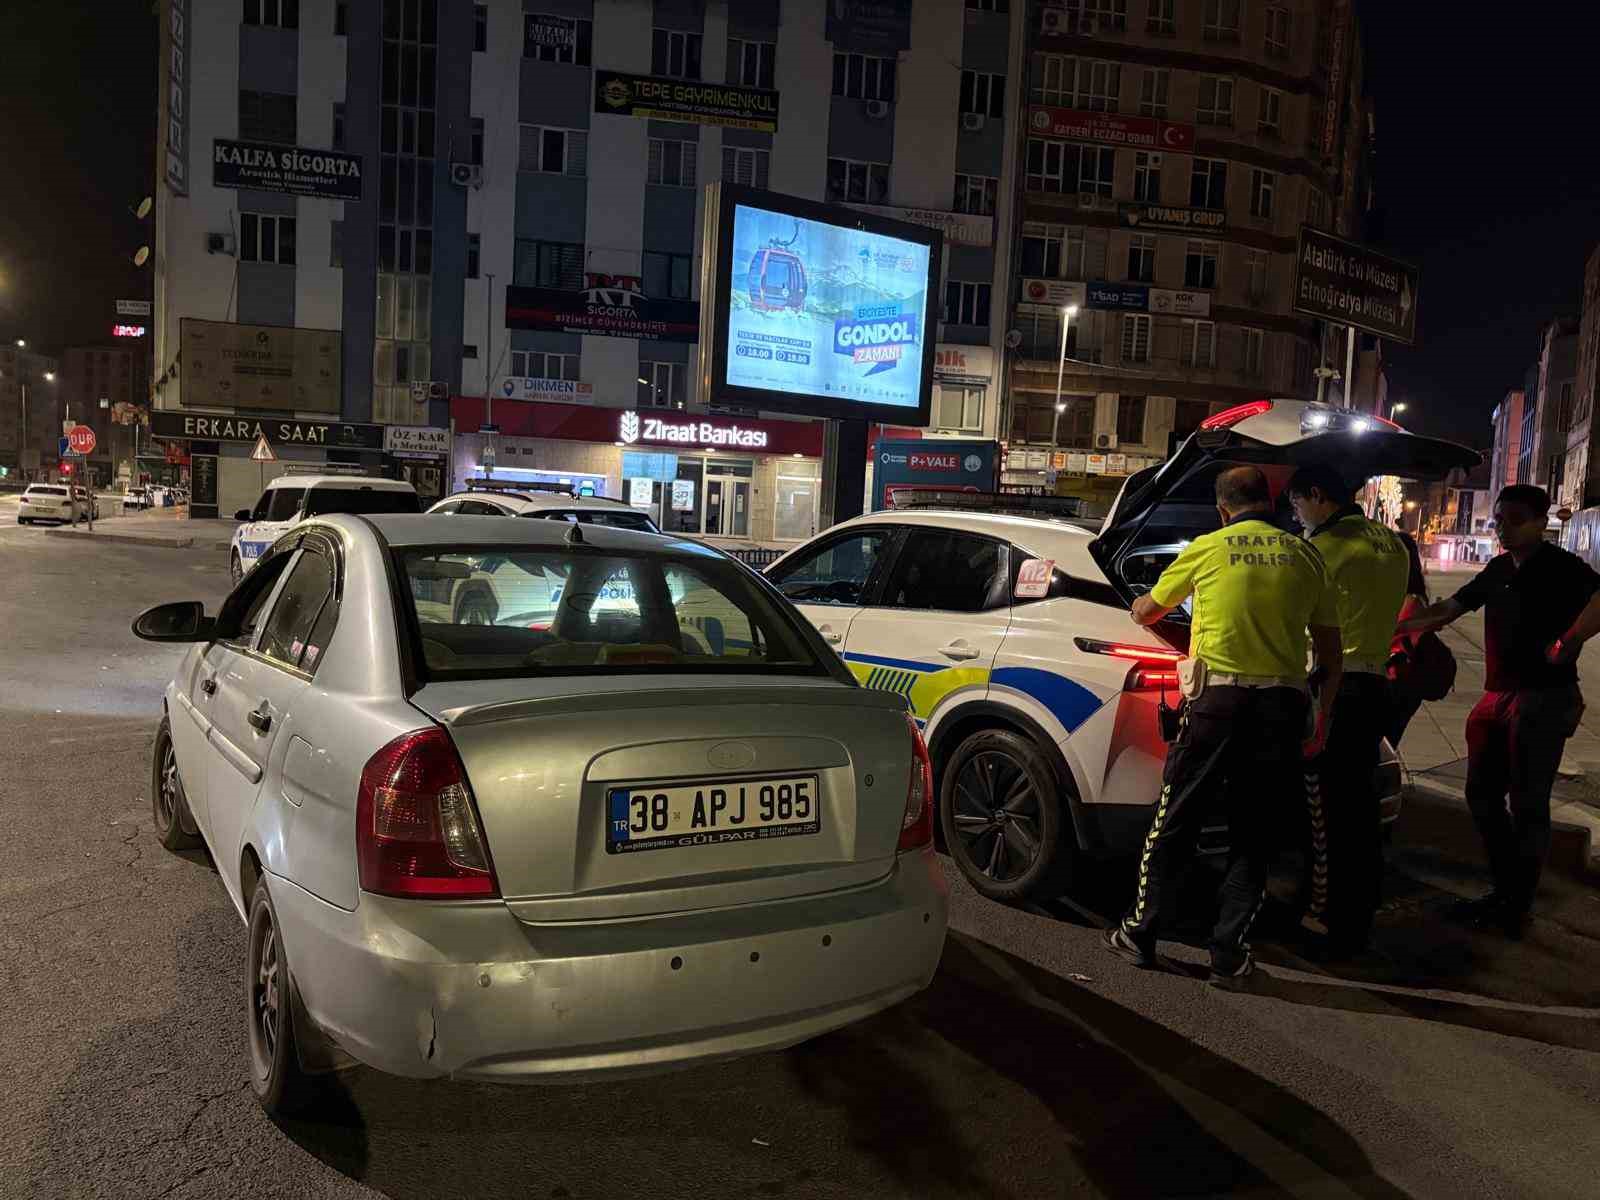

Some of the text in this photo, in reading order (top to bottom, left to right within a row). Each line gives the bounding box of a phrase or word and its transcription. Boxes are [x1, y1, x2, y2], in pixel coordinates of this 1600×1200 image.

[632, 79, 671, 99] TEPE
[215, 145, 360, 178] KALFA SİGORTA
[1192, 210, 1225, 226] GRUP
[1303, 242, 1346, 276] Atatürk
[1366, 264, 1399, 294] Müzesi
[1363, 296, 1396, 326] Müzesi
[838, 321, 913, 347] GONDOL
[71, 432, 94, 446] DUR
[185, 417, 329, 447] ERKARA SAAT
[393, 428, 446, 443] ÖZ-KAR
[699, 422, 768, 447] Bankası
[630, 782, 811, 834] 38 APJ 985
[613, 820, 629, 832] TR
[678, 831, 756, 847] GÜLPAR
